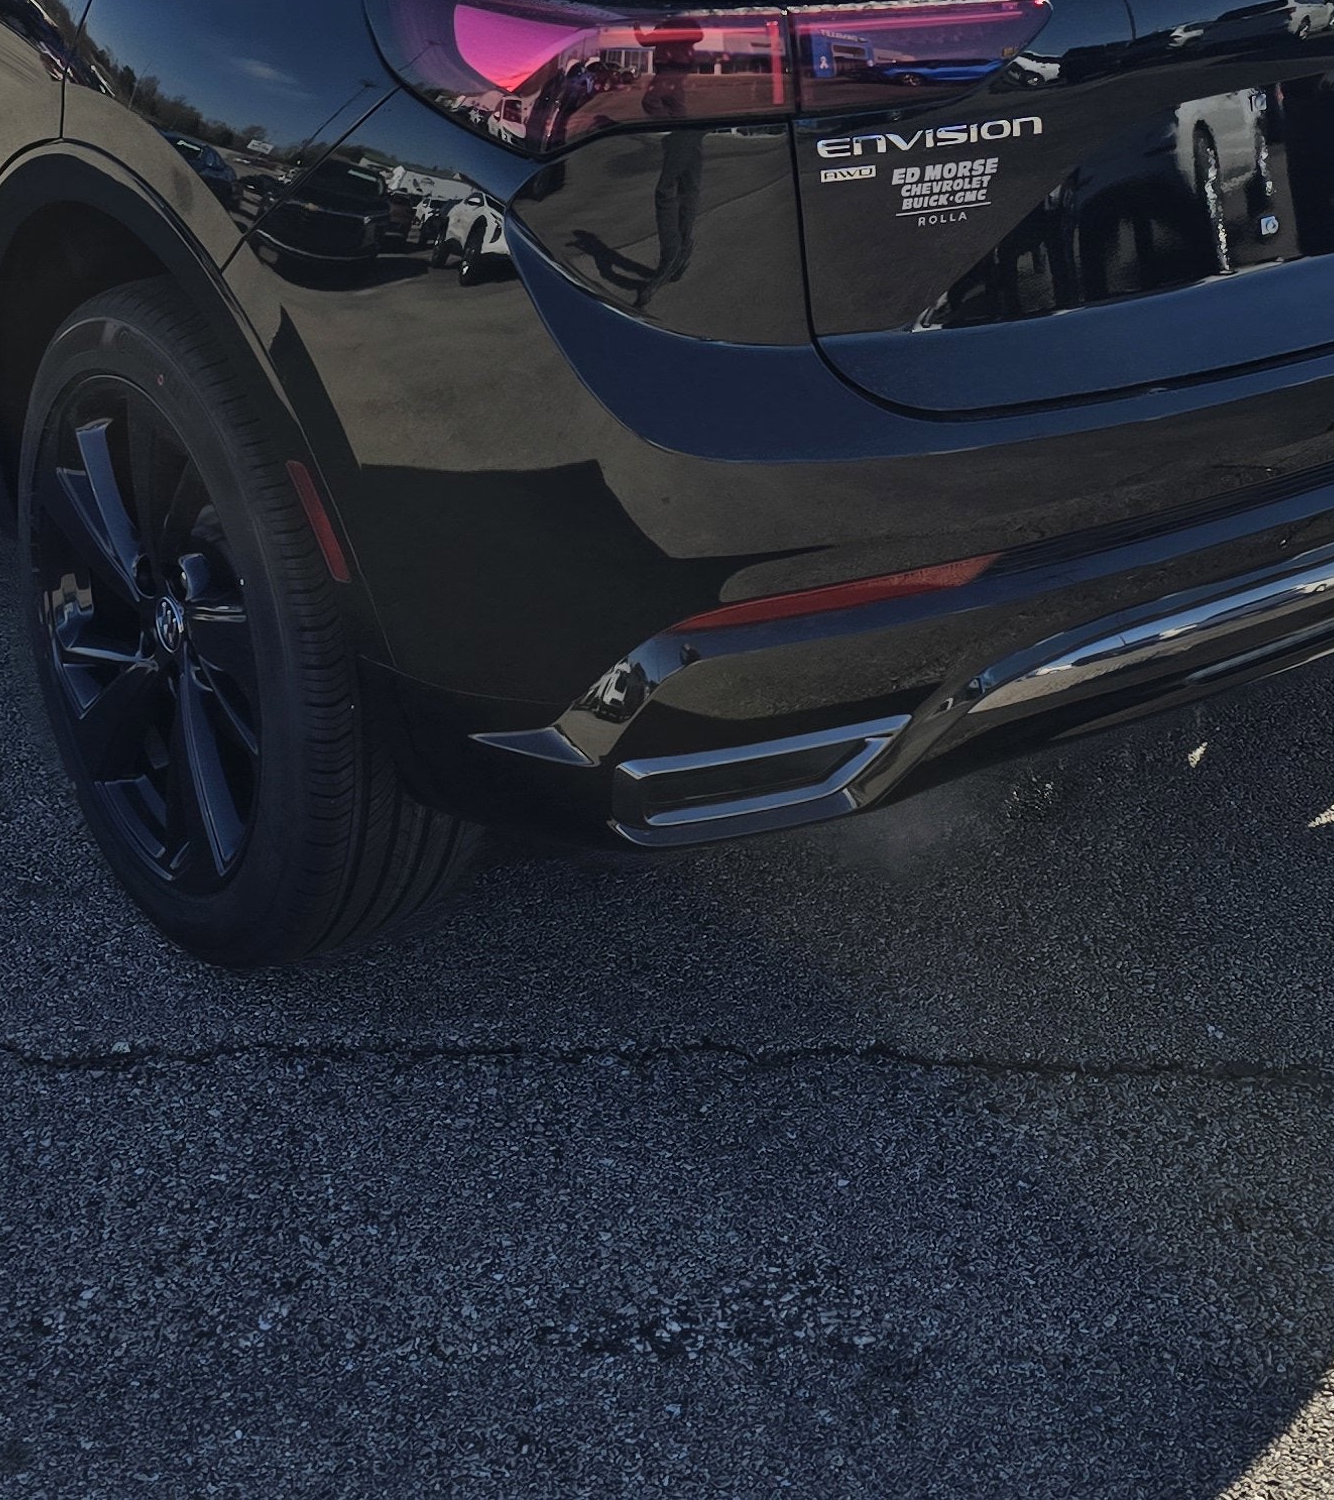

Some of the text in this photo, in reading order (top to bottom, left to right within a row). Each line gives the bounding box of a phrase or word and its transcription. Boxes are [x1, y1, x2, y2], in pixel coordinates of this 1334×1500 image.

[817, 116, 1043, 159] ENVISION
[822, 165, 875, 182] AWD
[891, 157, 999, 185] ED MORSE
[900, 175, 992, 198] CHEVROLET
[917, 211, 968, 227] ROLLA
